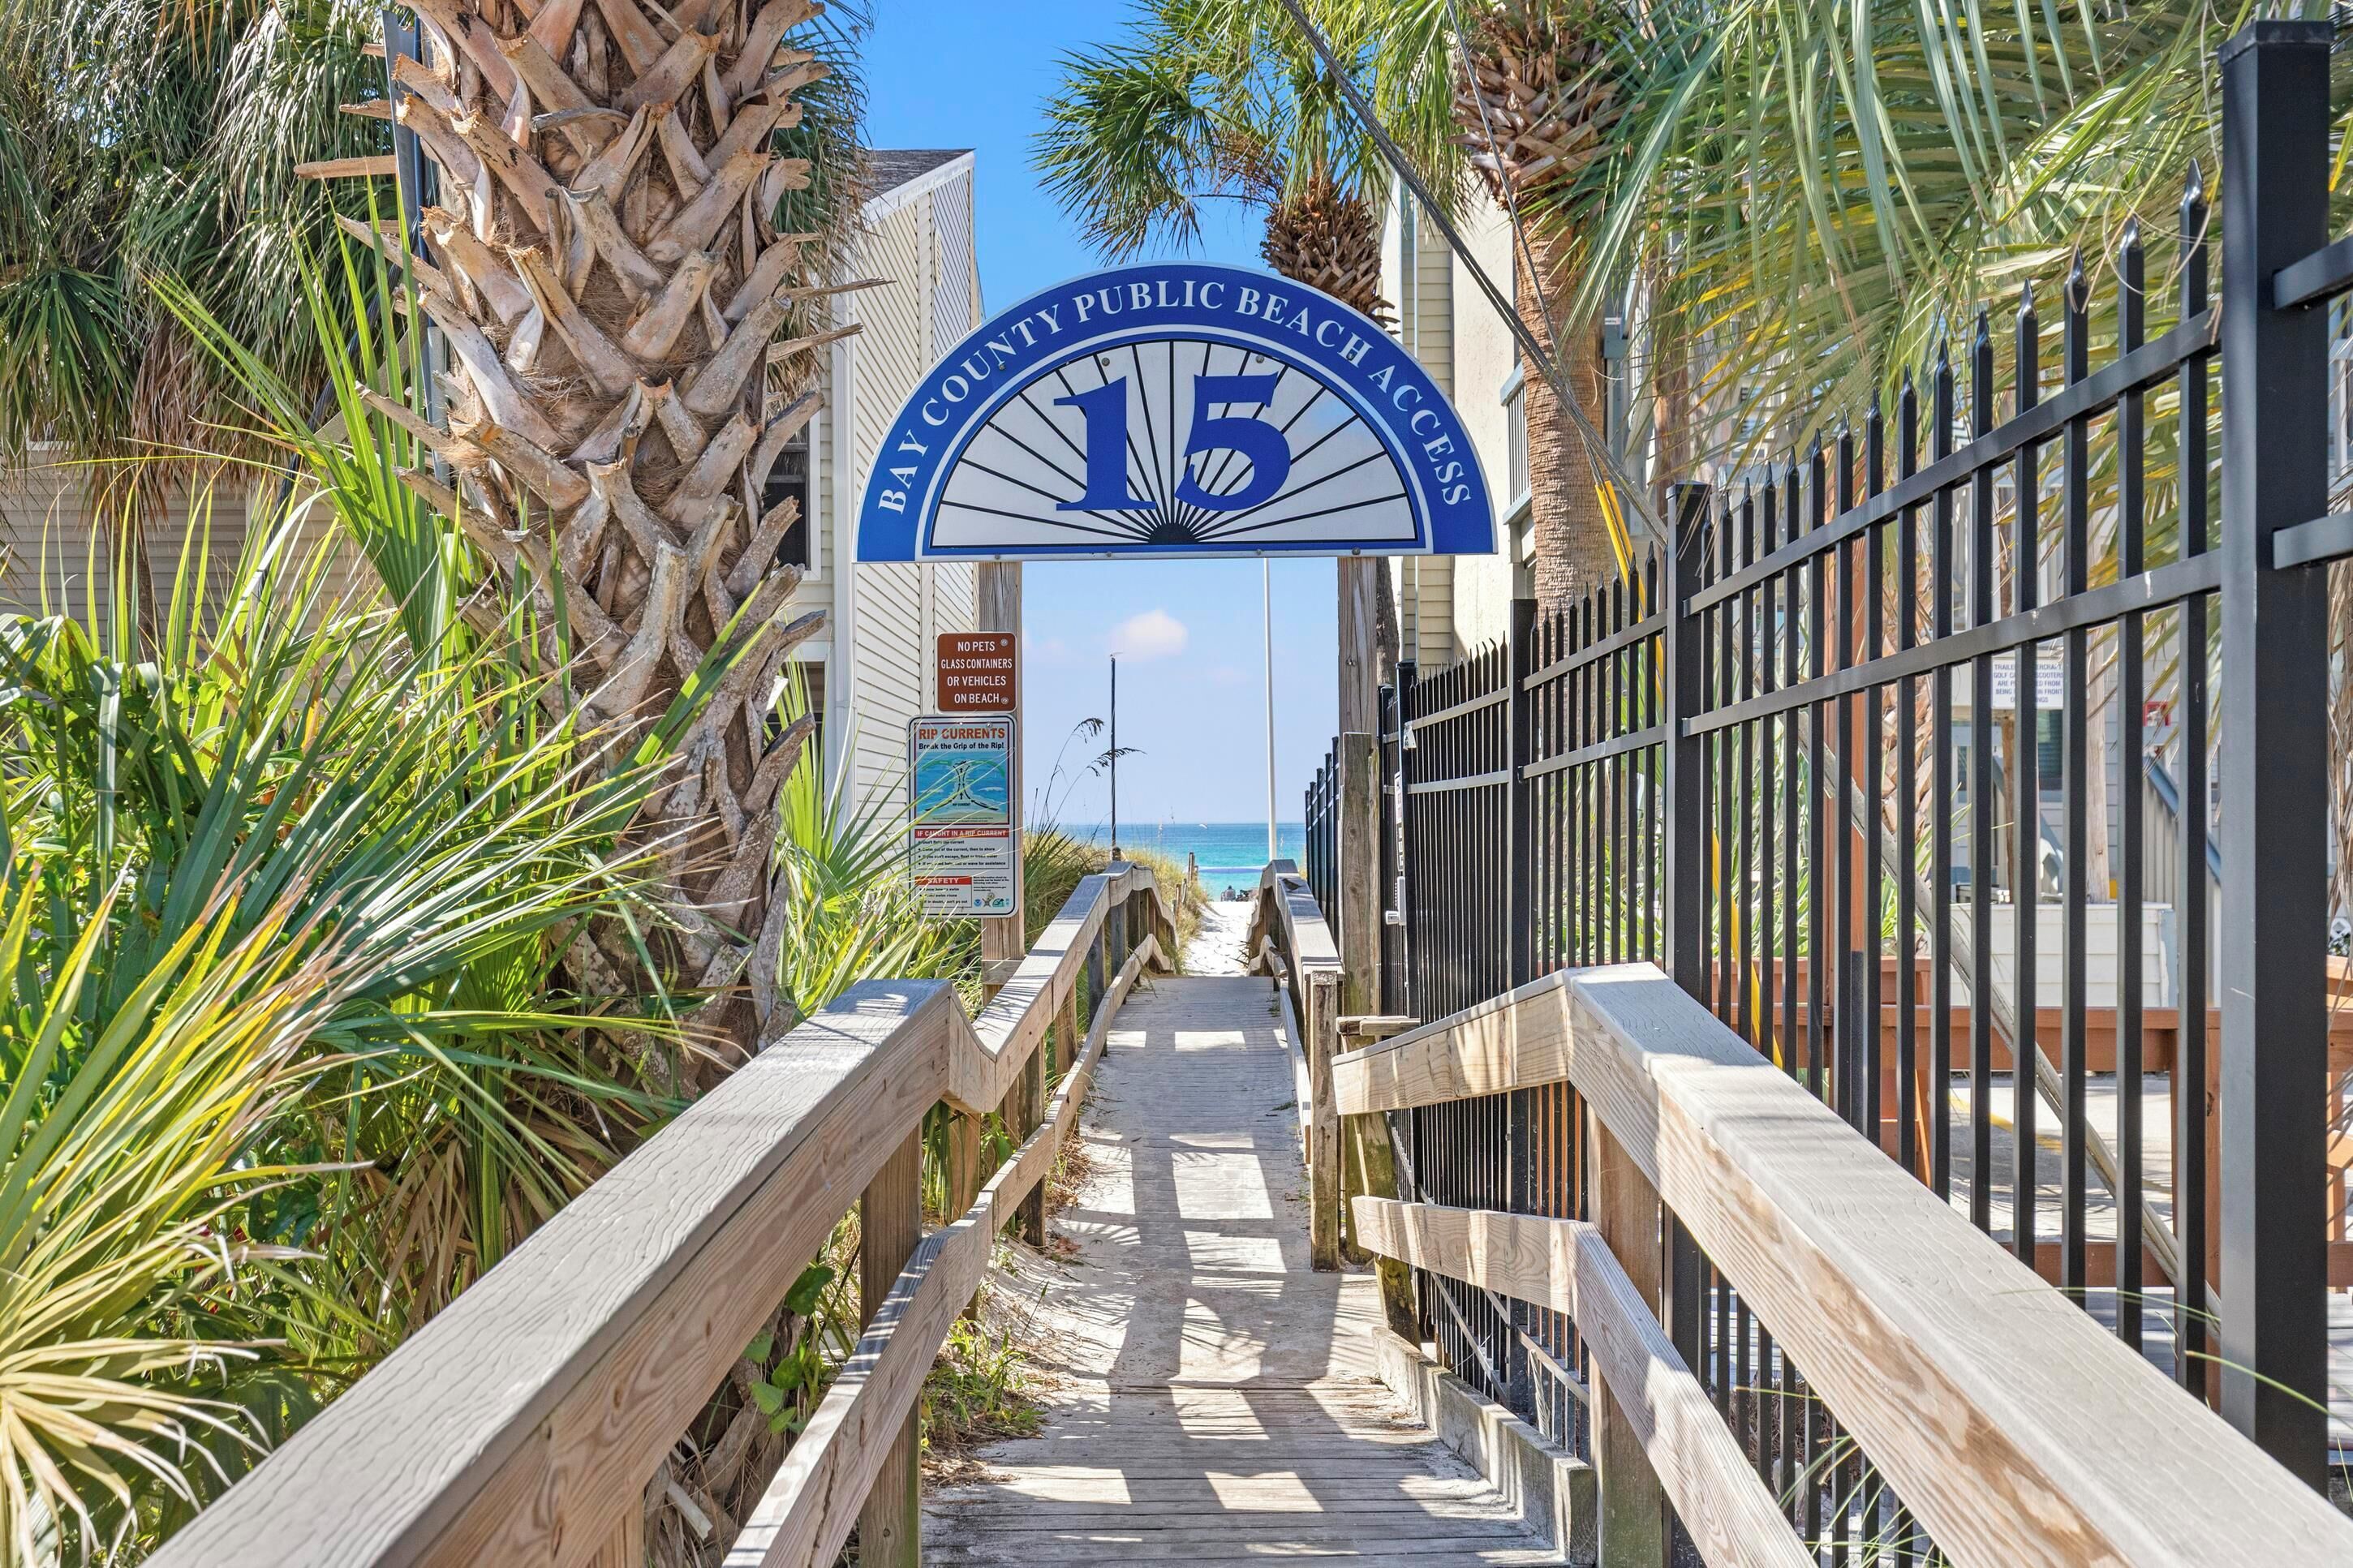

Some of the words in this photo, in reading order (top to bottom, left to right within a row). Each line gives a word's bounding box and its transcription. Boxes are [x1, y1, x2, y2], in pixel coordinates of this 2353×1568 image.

[879, 428, 928, 514] BAY
[923, 305, 1062, 427] COUNTY
[1072, 280, 1225, 324] PUBLIC
[1236, 286, 1374, 368] BEACH
[1368, 363, 1473, 507] ACCESS
[1053, 372, 1293, 511] 15
[957, 642, 970, 651] NO
[972, 641, 996, 651] PETS
[941, 659, 965, 669] GLASS
[966, 658, 1013, 669] CONTAINERS
[947, 676, 960, 686] OR
[961, 676, 1006, 686] VEHICLES
[954, 694, 967, 703] ON
[969, 693, 1000, 703] BEACH
[918, 728, 938, 740] RIP
[941, 728, 1005, 739] CURRENTS
[953, 742, 967, 750] Grip
[991, 741, 1004, 750] Rip!
